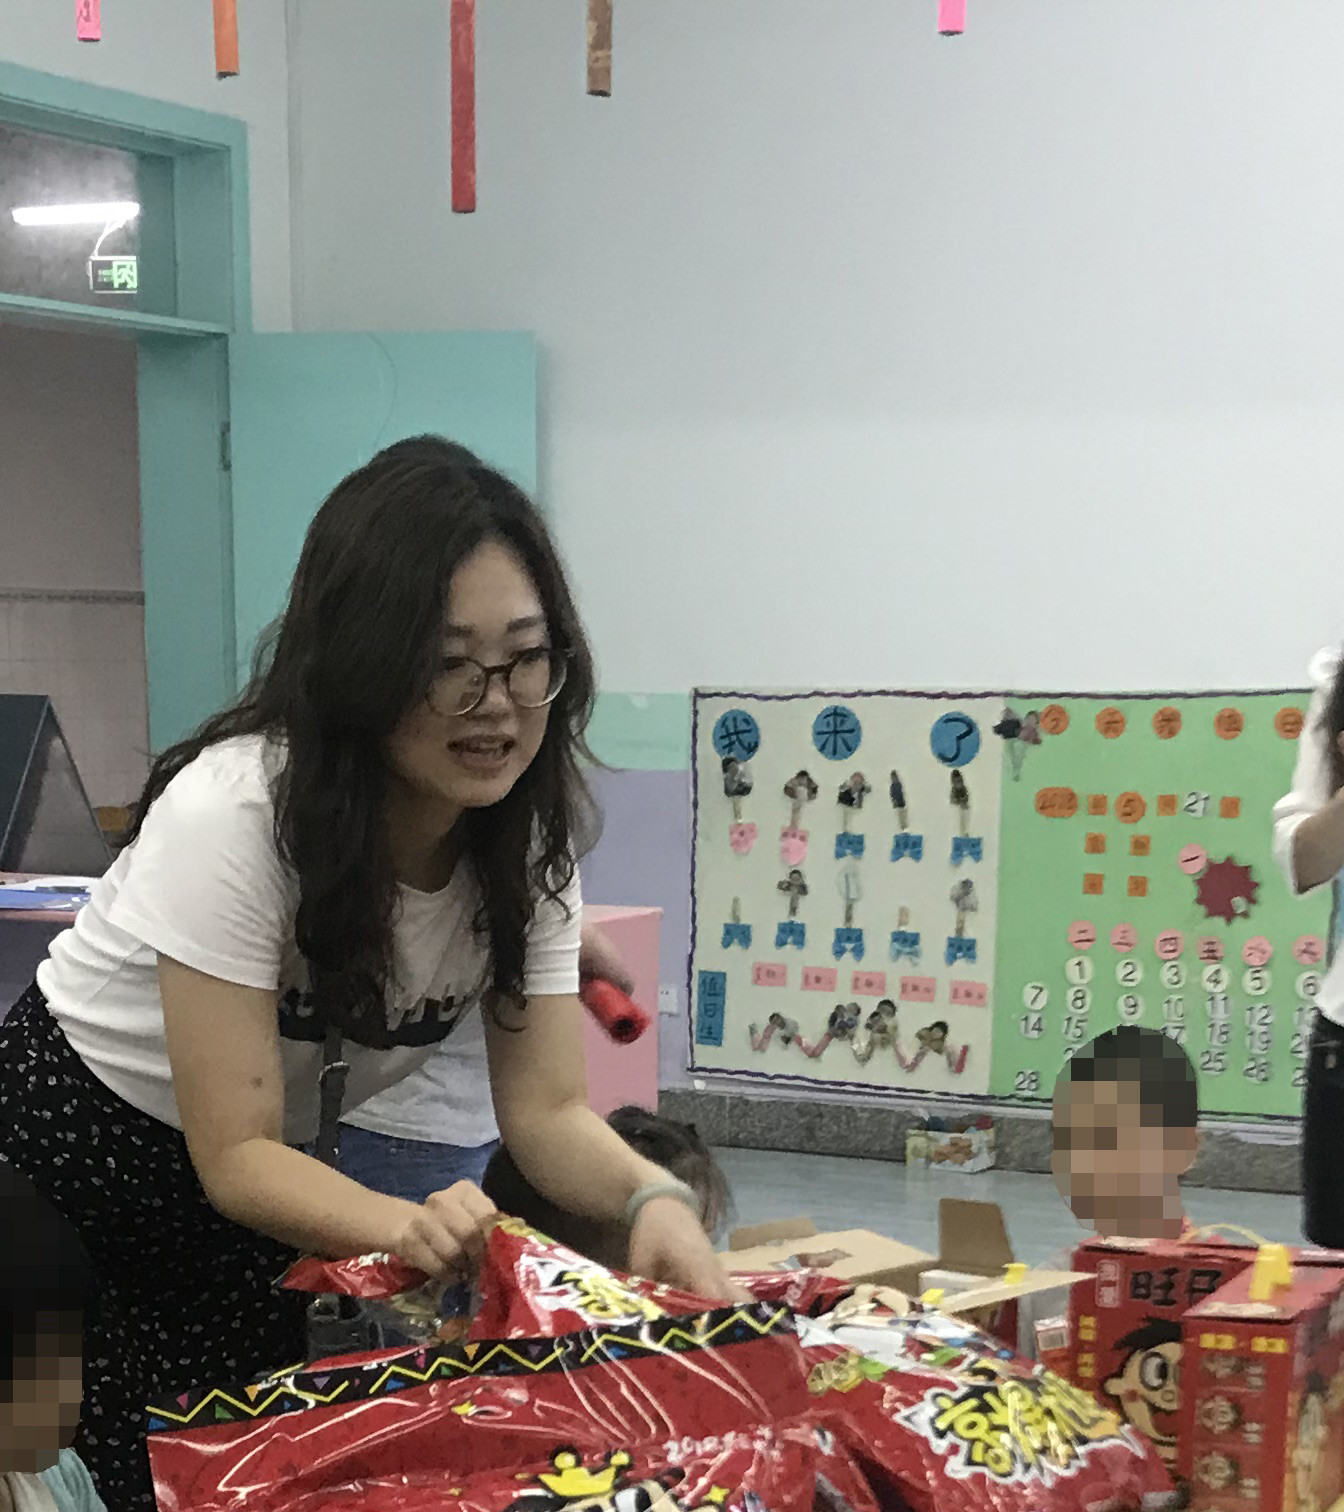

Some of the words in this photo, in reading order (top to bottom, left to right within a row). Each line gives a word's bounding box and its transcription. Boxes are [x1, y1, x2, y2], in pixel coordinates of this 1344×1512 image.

[1074, 960, 1086, 980] 1
[1121, 961, 1137, 983] 2
[1166, 964, 1182, 985] 3
[1205, 967, 1224, 986] 4
[1250, 968, 1265, 992] 5
[1302, 974, 1317, 996] 6
[1030, 985, 1044, 1006] 7
[1071, 989, 1087, 1010] 8
[1123, 995, 1139, 1016] 9
[1164, 997, 1185, 1019] 10
[1207, 996, 1230, 1018] 11
[1245, 1004, 1273, 1026] 12
[1021, 1015, 1044, 1036] 14
[1064, 1016, 1089, 1039] 15
[1208, 1023, 1231, 1045] 18
[1247, 1031, 1272, 1051] 19
[1015, 1071, 1040, 1092] 28
[1200, 1050, 1227, 1073] 25
